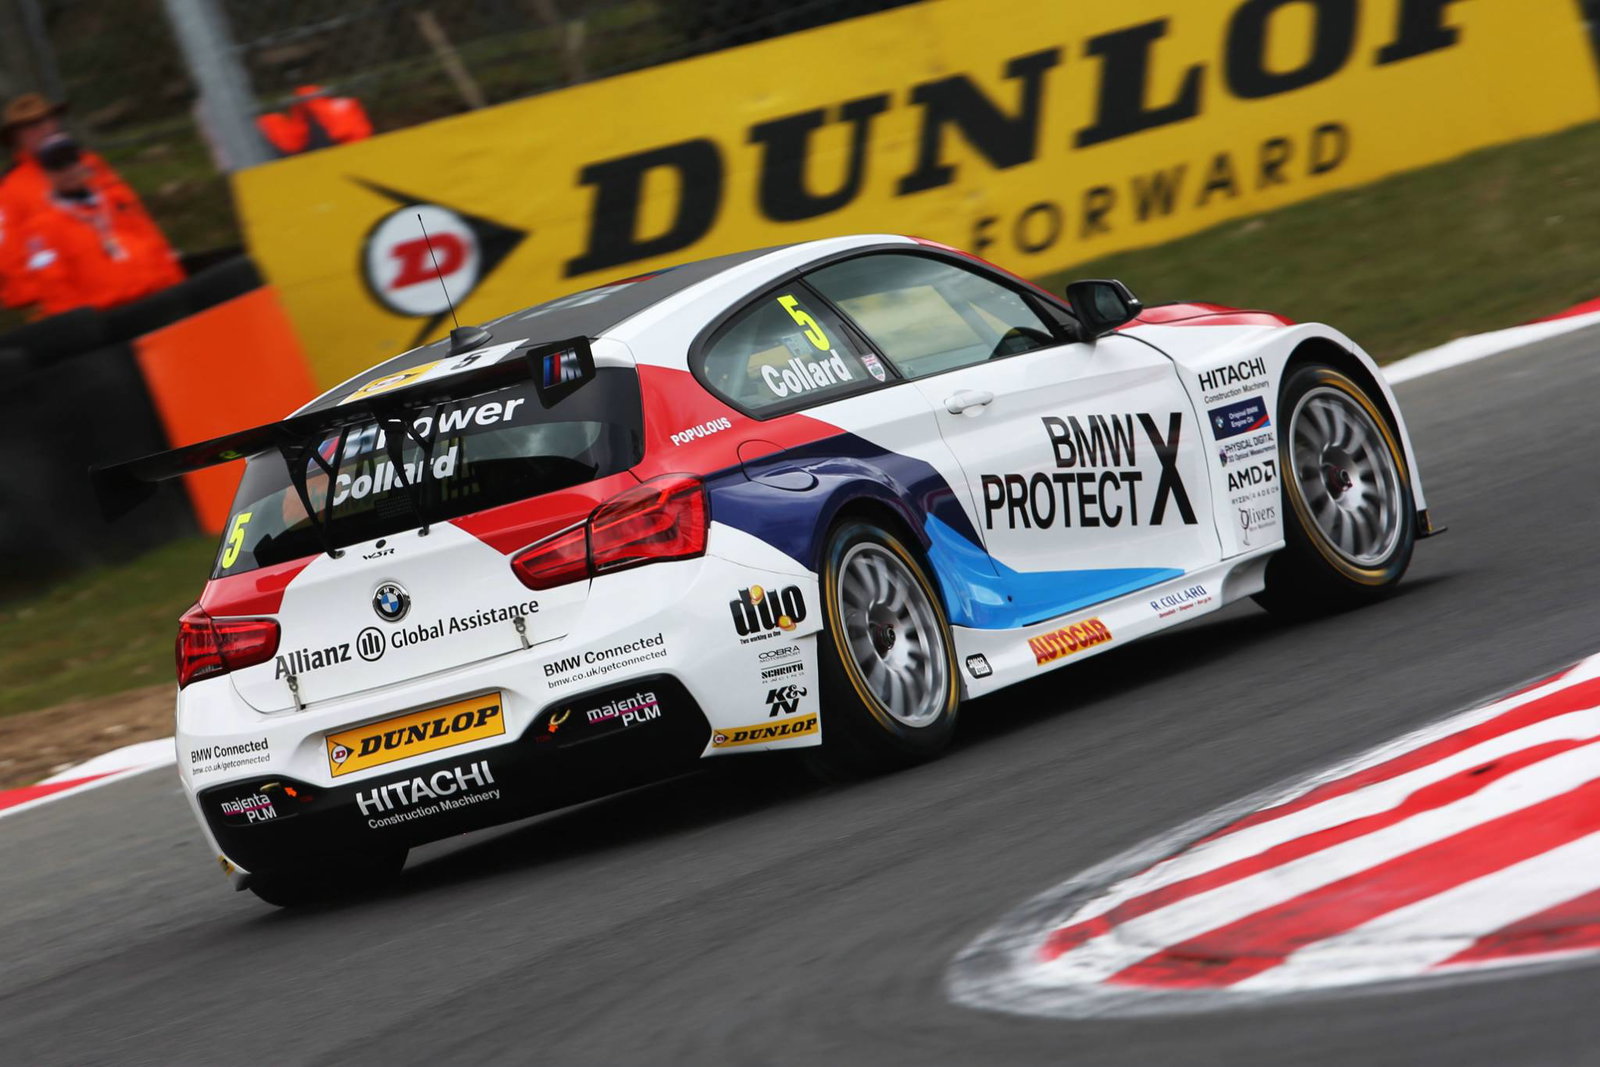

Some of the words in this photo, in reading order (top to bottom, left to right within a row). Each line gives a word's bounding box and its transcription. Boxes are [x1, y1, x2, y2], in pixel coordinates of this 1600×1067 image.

[973, 119, 1352, 258] FORWARD
[777, 294, 830, 351] 5
[761, 349, 853, 397] Collard
[1198, 356, 1266, 392] HITACHI
[1204, 388, 1242, 404] Construction
[1241, 380, 1270, 393] Machinery
[670, 417, 732, 446] POPULOUS
[1041, 413, 1136, 468] BMW
[1225, 438, 1253, 453] PHYSICAL
[1136, 412, 1198, 526] X
[1228, 466, 1262, 492] AMD
[981, 470, 1142, 530] PROTECT
[222, 512, 253, 569] 5
[730, 584, 807, 636] duo
[275, 643, 352, 680] Allianz
[391, 619, 445, 649] Global
[448, 600, 540, 635] Assistance
[543, 655, 581, 677] BMW
[584, 633, 664, 664] Connected
[759, 645, 800, 659] COBRA
[1029, 617, 1112, 664] AUTOCAR
[548, 648, 668, 689] bmw.co.uk/getconnected
[761, 663, 804, 679] SCHROTH
[587, 691, 657, 722] majenta
[621, 704, 662, 727] PLM
[191, 746, 212, 763] BMW
[214, 737, 269, 758] Connected
[358, 705, 500, 758] DUNLOP
[731, 718, 818, 743] DUNLOP
[193, 753, 270, 775] bmw.co.uk/getconnected
[221, 793, 271, 814] majenta
[355, 760, 495, 816] HITACHI
[246, 806, 277, 823] PLM
[368, 803, 440, 829] Construction
[440, 789, 501, 811] Machinery
